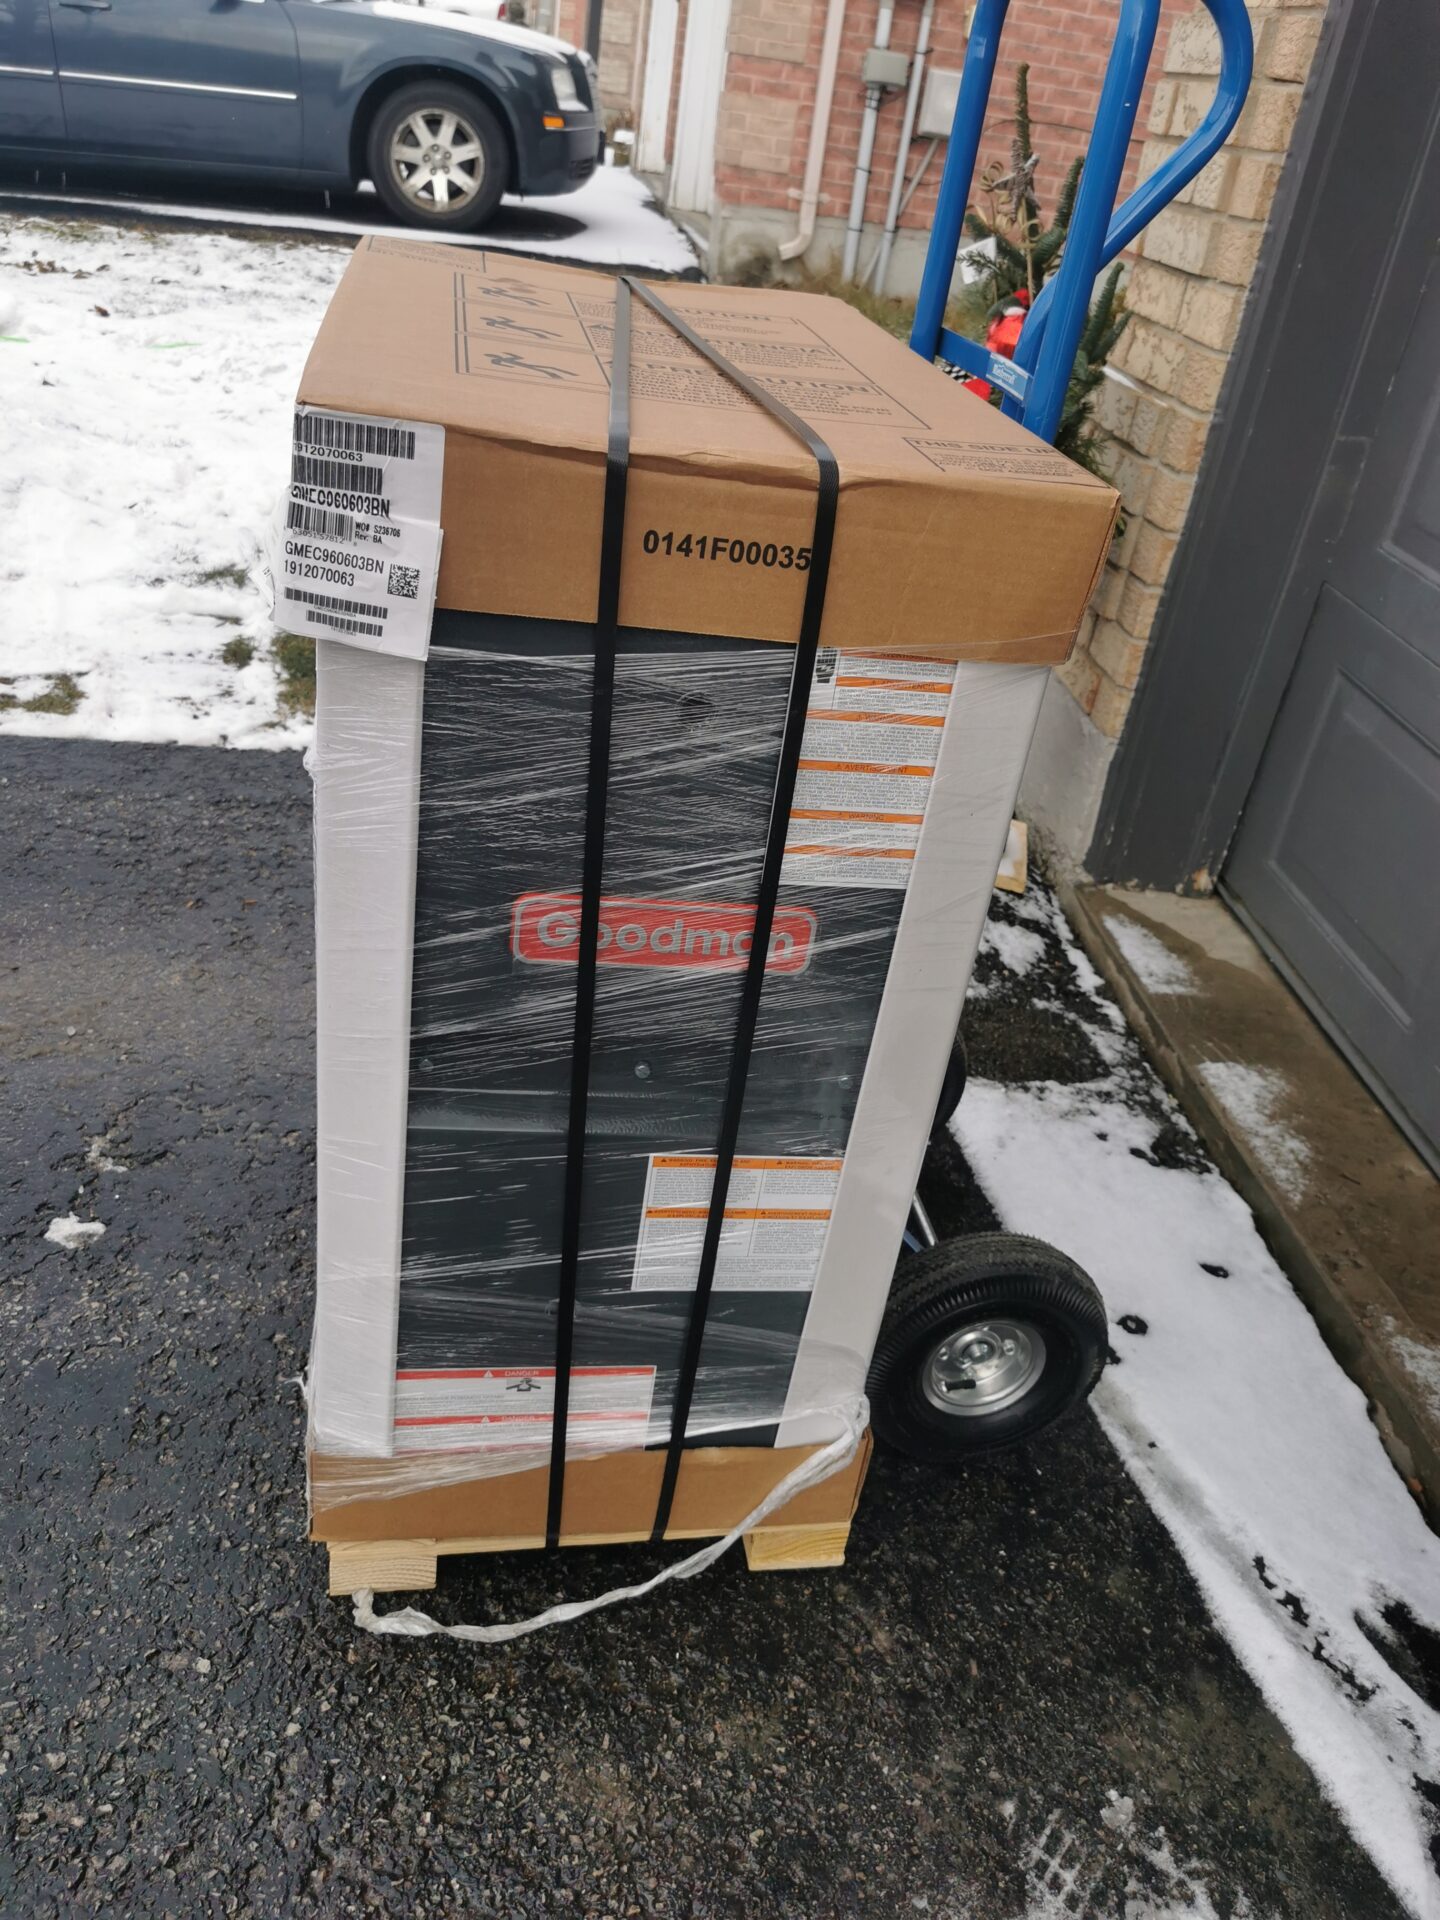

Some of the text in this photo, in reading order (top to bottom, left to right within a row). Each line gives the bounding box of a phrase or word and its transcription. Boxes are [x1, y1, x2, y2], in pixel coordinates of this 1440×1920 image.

[912, 440, 963, 449] THIS
[967, 444, 1021, 453] SIDE
[284, 540, 385, 575] GMEC960603BN
[642, 529, 812, 571] 0141F00035
[284, 559, 355, 587] 1912070063
